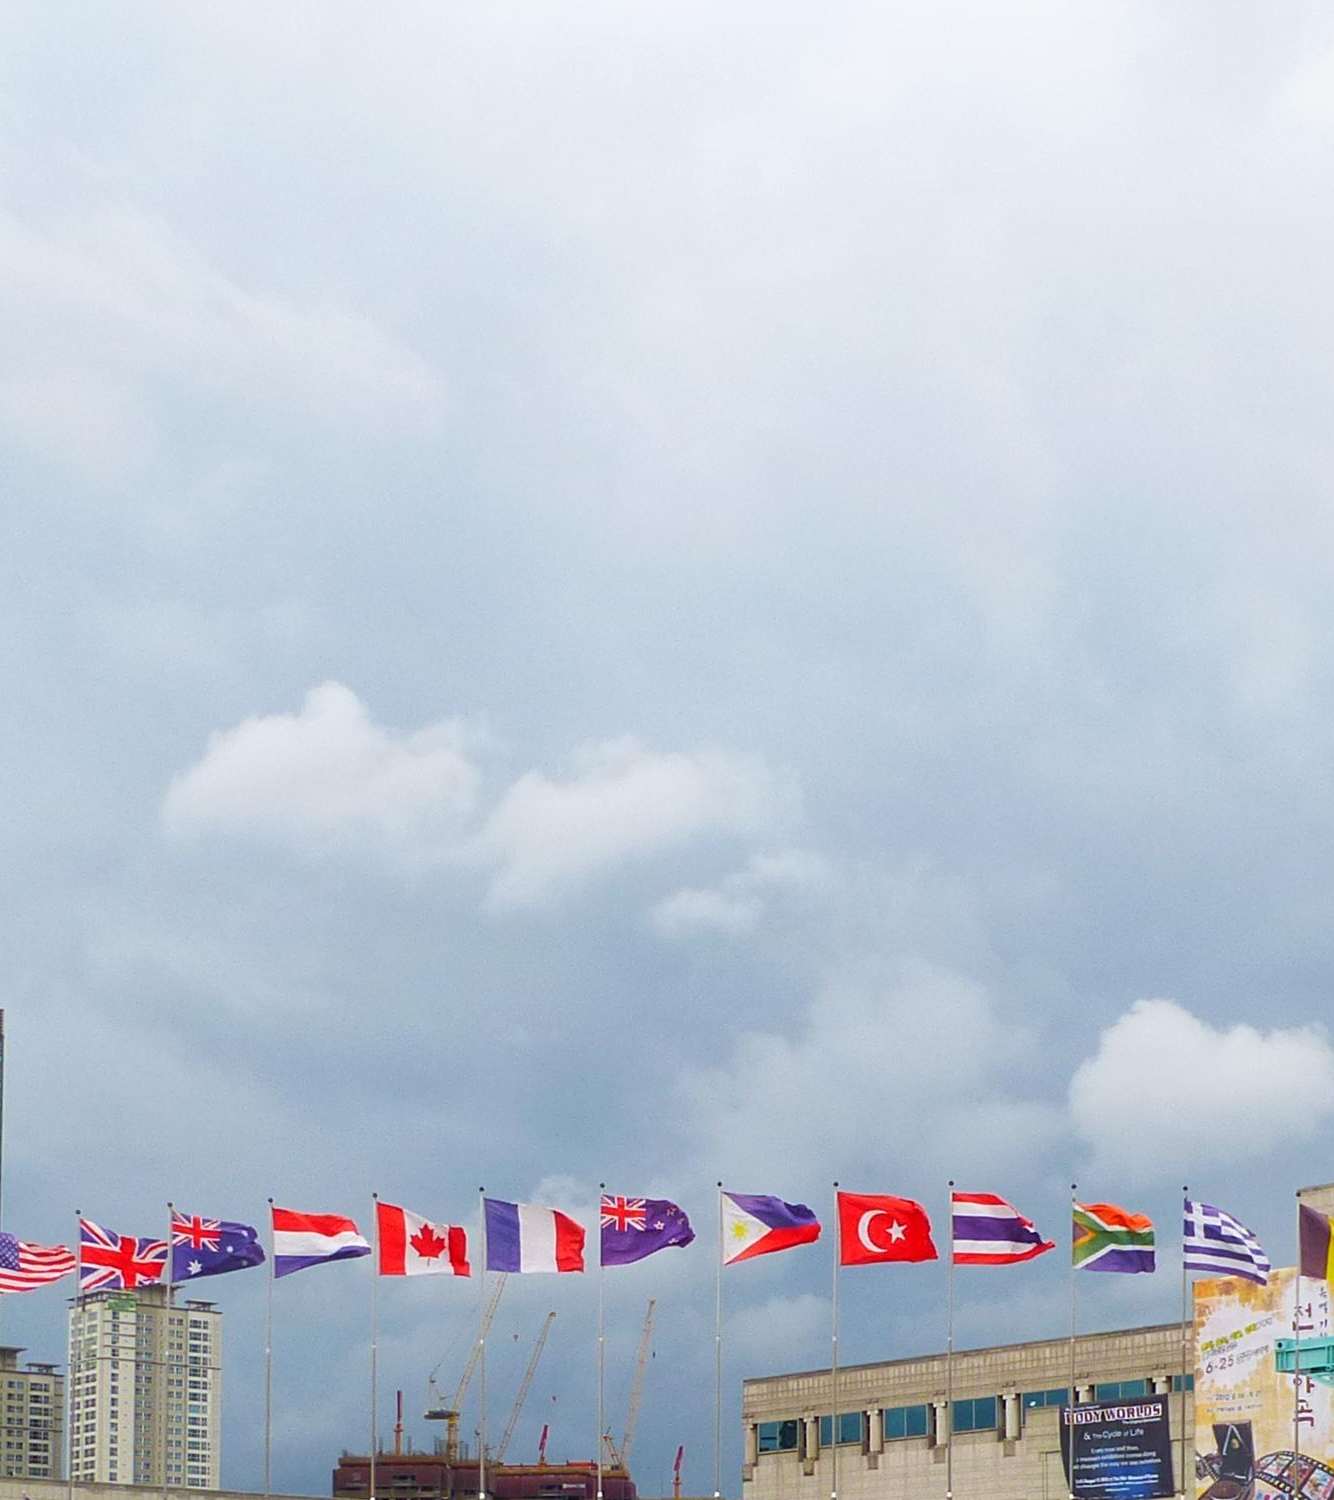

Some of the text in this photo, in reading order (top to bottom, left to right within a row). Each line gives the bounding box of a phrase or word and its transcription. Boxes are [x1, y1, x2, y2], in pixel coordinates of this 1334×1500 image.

[1103, 1403, 1162, 1421] WORLDS
[1102, 1430, 1122, 1439] Cycle
[1129, 1428, 1144, 1436] Life
